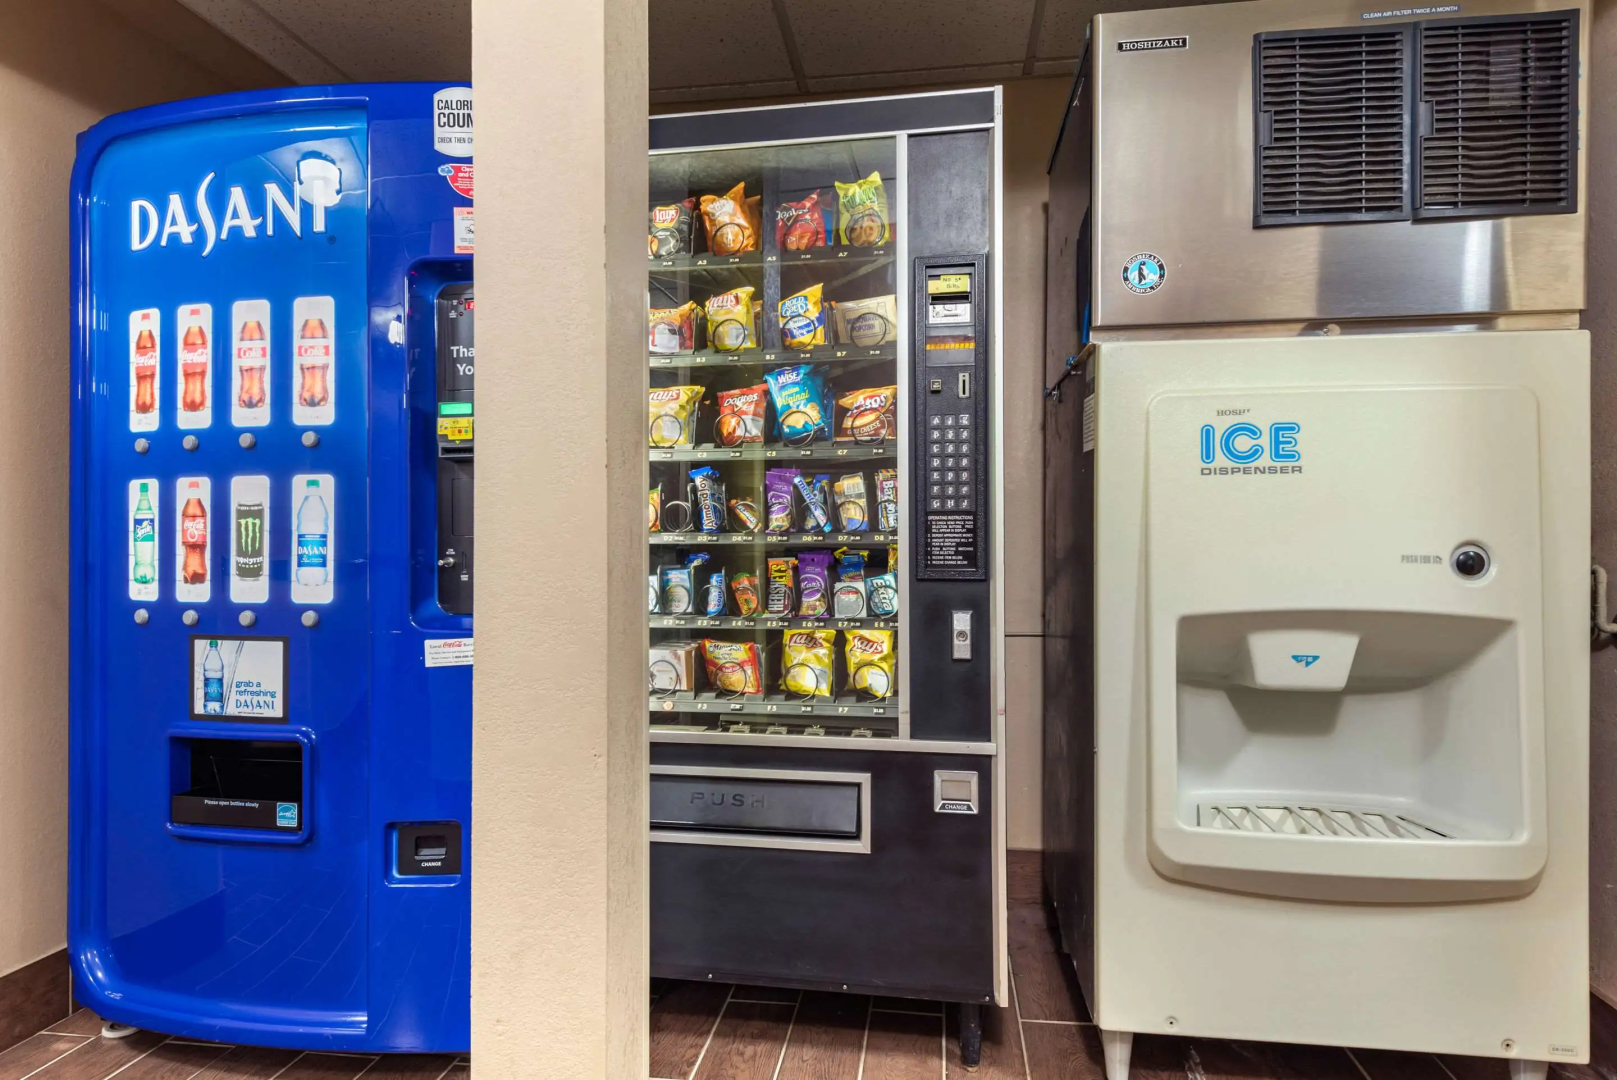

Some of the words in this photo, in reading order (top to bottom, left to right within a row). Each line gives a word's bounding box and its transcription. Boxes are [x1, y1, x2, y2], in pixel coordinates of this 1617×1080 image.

[1122, 39, 1184, 50] HOSHIZAKI
[130, 172, 327, 257] DASANI
[785, 297, 804, 308] ROLD
[450, 346, 474, 358] Tha
[456, 364, 474, 375] Yo
[778, 371, 798, 384] WISE
[724, 393, 758, 406] Doritos
[860, 420, 881, 434] CHEESE
[1201, 422, 1301, 464] ICE
[1200, 465, 1303, 476] DISPENSER
[702, 492, 715, 529] Almond
[298, 544, 326, 556] DASANI
[443, 641, 462, 649] Coca-Cola
[789, 633, 822, 646] Lay's
[236, 680, 254, 688] grab
[236, 689, 277, 698] refreshing
[236, 697, 274, 711] DASANI
[690, 791, 766, 808] PUSH
